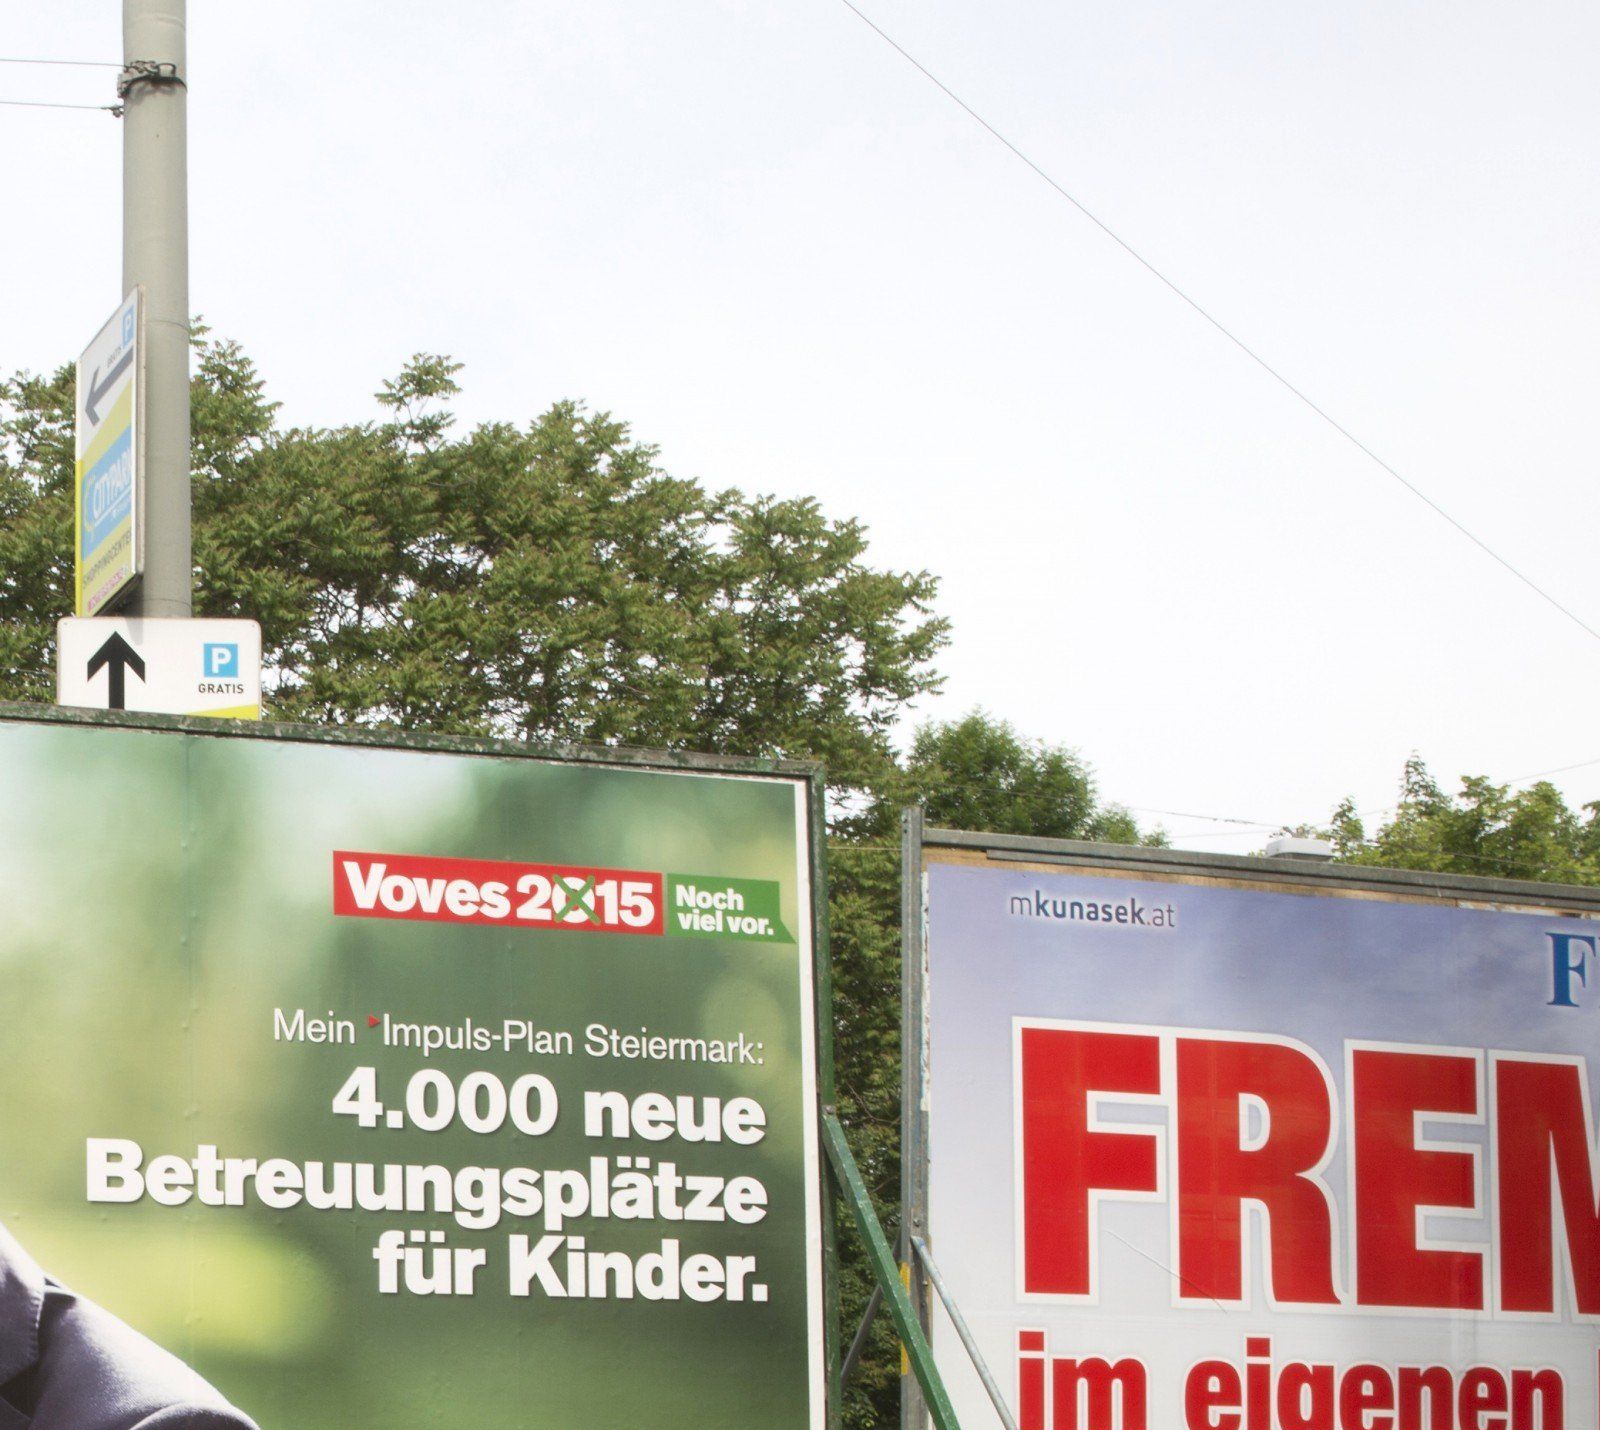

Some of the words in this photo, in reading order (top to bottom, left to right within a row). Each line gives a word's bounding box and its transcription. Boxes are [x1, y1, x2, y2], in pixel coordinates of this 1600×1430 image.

[198, 683, 244, 694] GRATIS
[211, 647, 232, 674] P
[342, 860, 510, 919] Voves
[516, 873, 655, 927] 2015
[675, 884, 744, 911] Noch
[1010, 889, 1175, 928] mkunasek.at
[677, 909, 723, 932] viel
[726, 915, 774, 936] vor.
[1545, 932, 1600, 1008] F
[273, 1008, 356, 1044] Mein
[383, 1013, 574, 1058] Impuls-Plan
[584, 1023, 764, 1065] Steiermark:
[333, 1067, 559, 1136] 4.000
[584, 1091, 767, 1142] neue
[86, 1137, 768, 1231] Betreuungsplätze
[372, 1230, 486, 1295] für
[509, 1234, 768, 1302] Kinder.
